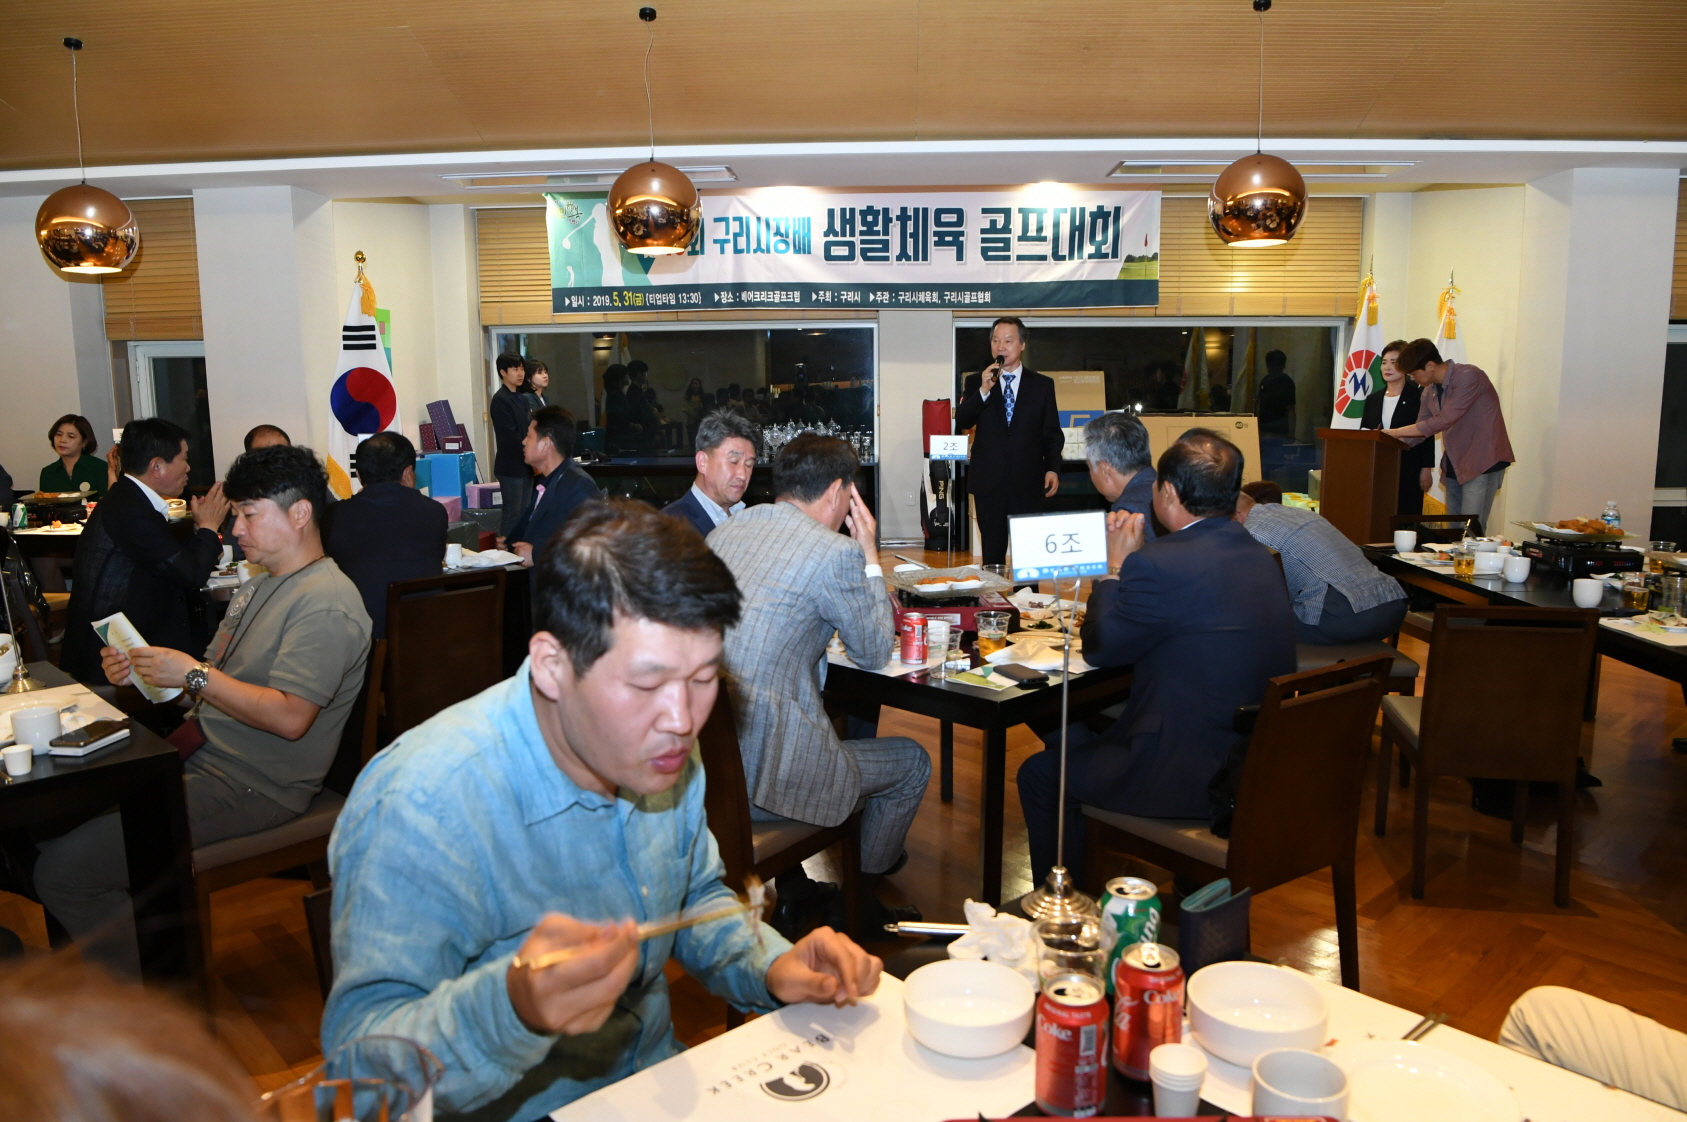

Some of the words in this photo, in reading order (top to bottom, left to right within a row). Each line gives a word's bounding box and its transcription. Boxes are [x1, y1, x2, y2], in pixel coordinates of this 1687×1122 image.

[713, 216, 812, 255] 구리시장배
[823, 205, 966, 262] 생활체육
[979, 204, 1122, 262] 골프대회
[571, 295, 585, 307] 일시
[592, 295, 612, 307] 2019.
[623, 290, 645, 307] 31(금)
[720, 291, 734, 304] 장소
[818, 291, 832, 303] 주최
[840, 291, 861, 303] 구리시
[875, 291, 890, 303] 주관
[943, 290, 991, 304] 구리시골프협회
[943, 442, 958, 451] 2조
[1045, 533, 1082, 554] 6조
